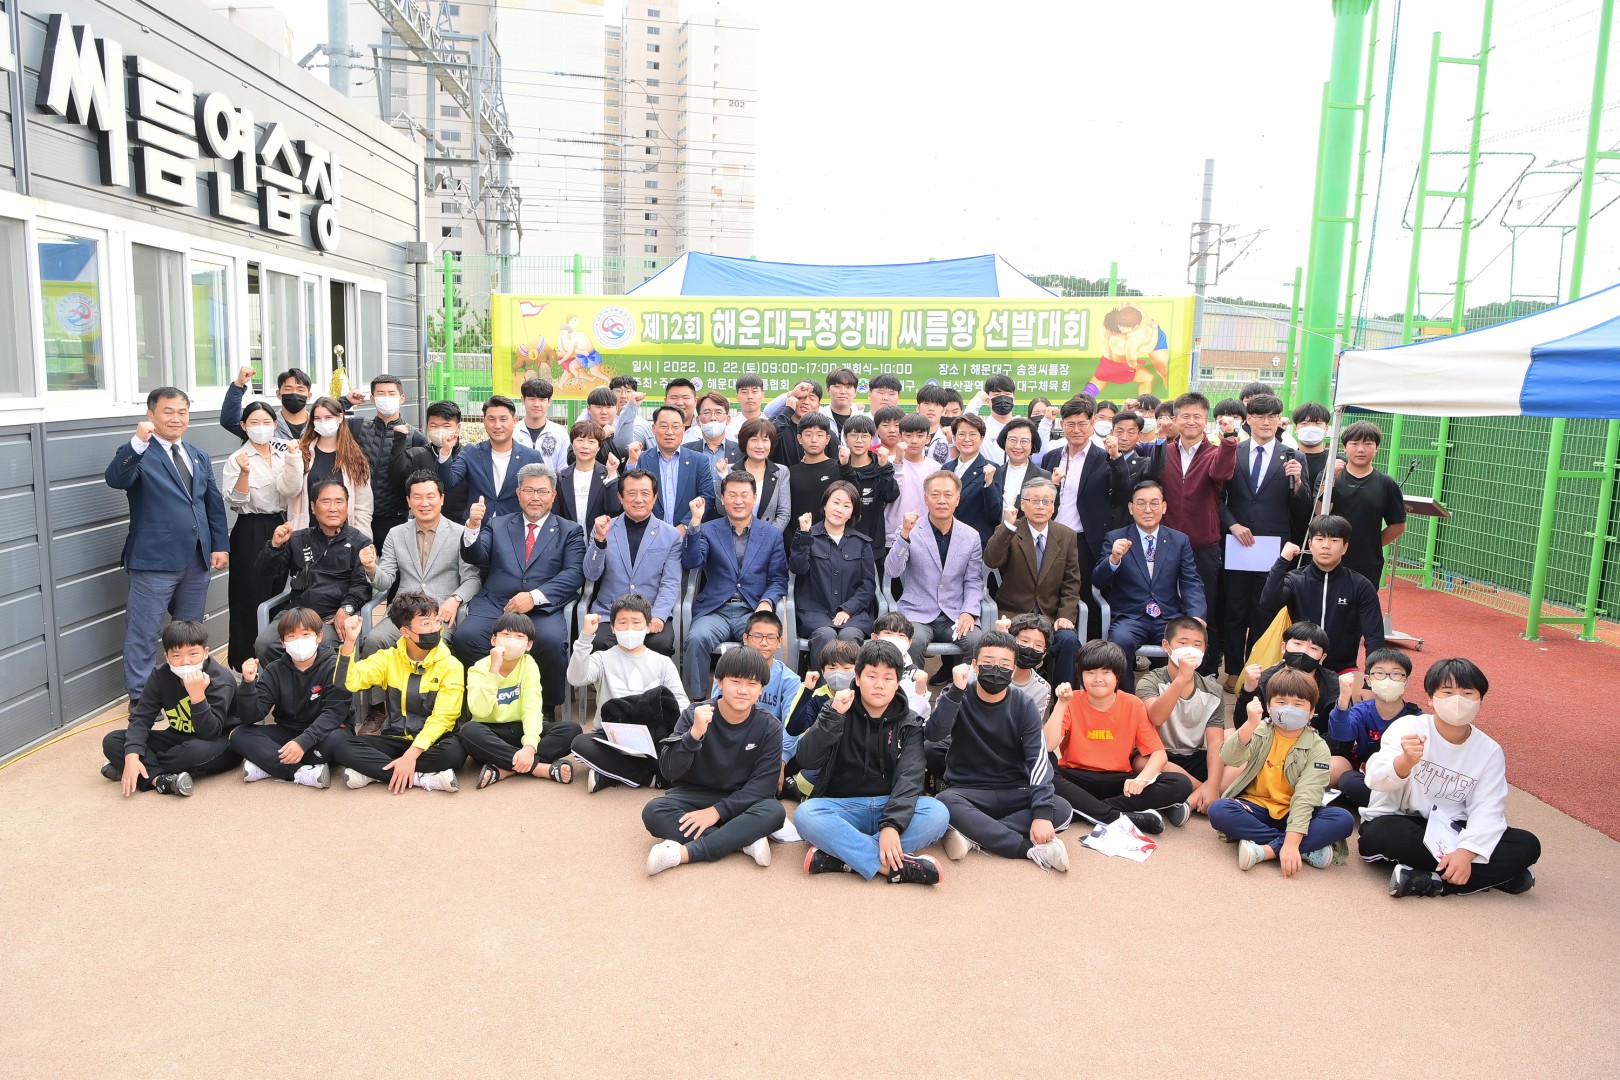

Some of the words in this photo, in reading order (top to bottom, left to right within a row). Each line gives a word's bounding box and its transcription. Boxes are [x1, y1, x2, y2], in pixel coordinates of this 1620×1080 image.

[728, 99, 745, 109] 202
[36, 13, 341, 253] 씨름연습장
[641, 312, 702, 342] 제12회
[711, 308, 890, 348] 해운대구청장배
[898, 309, 977, 349] 씨름왕
[984, 309, 1089, 349] 선발대회
[631, 360, 652, 373] 일시
[663, 361, 699, 373] 2022.
[703, 361, 719, 374] 10.
[938, 363, 960, 376] 장소
[970, 363, 1012, 376] 해운대구
[1016, 363, 1070, 376] 송정씨름장
[1087, 729, 1114, 740] NIKE
